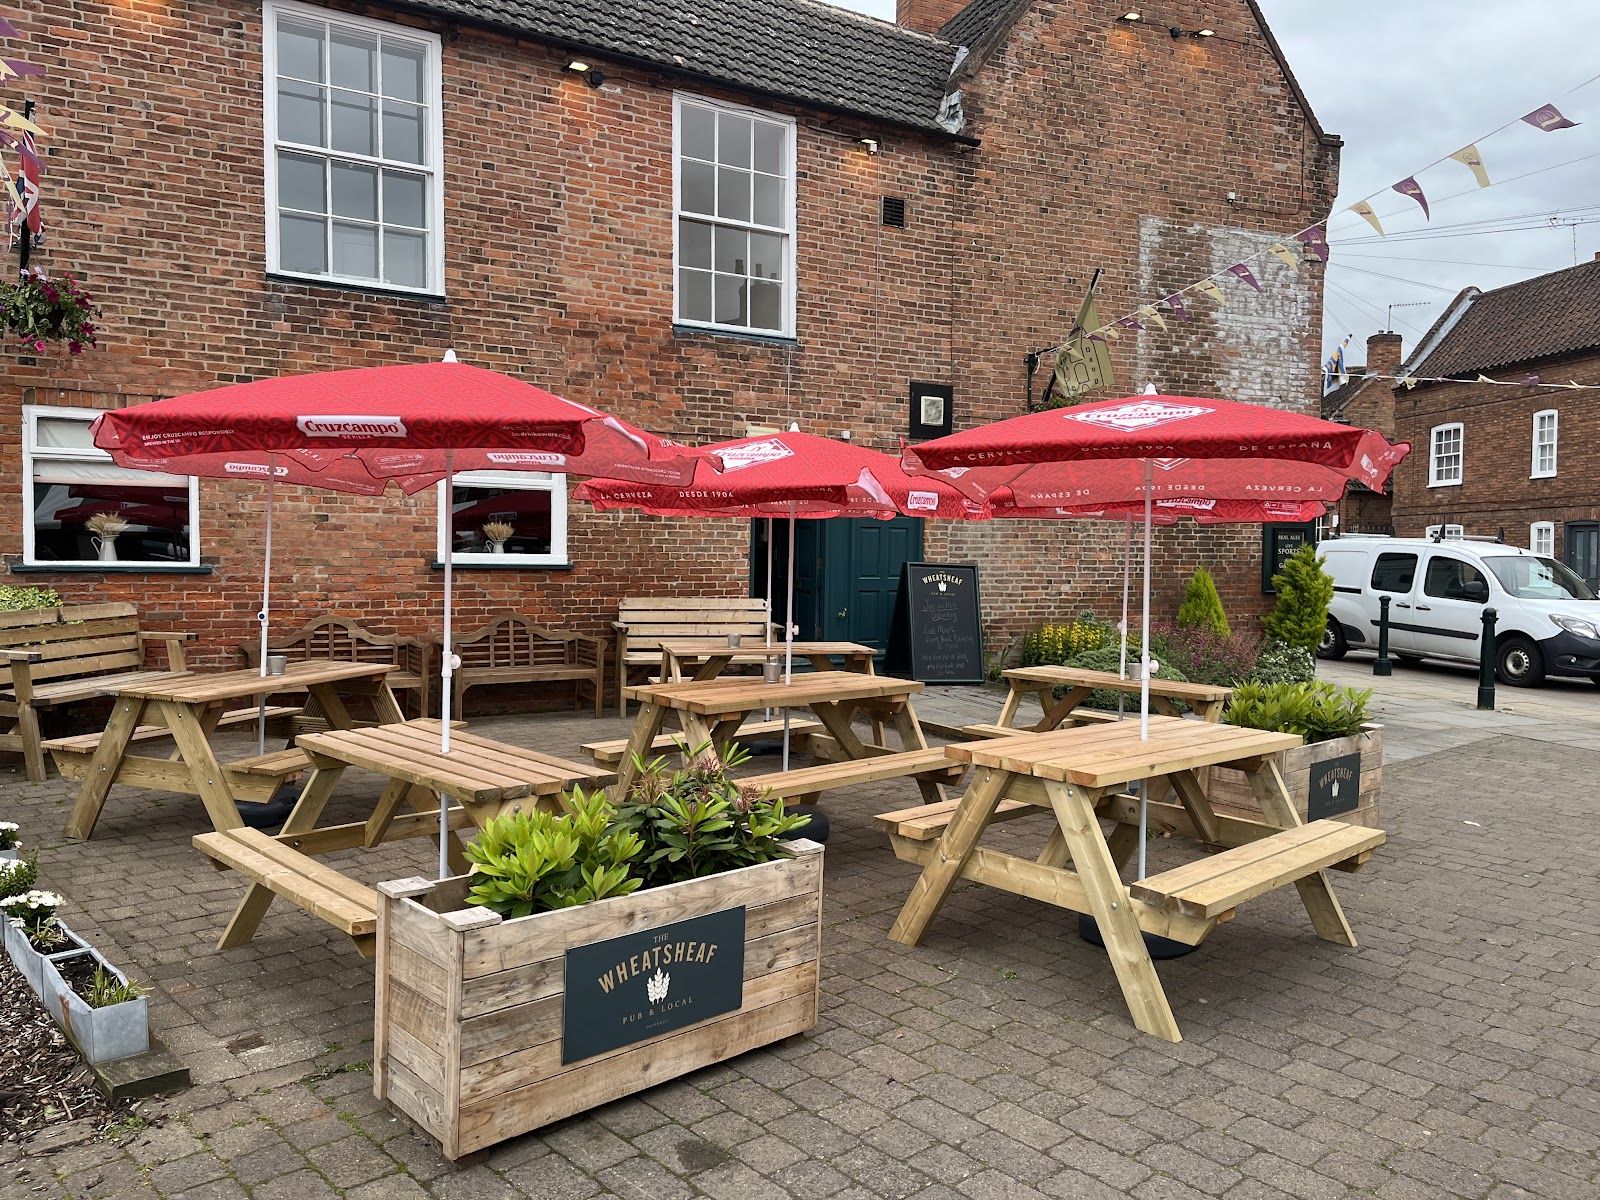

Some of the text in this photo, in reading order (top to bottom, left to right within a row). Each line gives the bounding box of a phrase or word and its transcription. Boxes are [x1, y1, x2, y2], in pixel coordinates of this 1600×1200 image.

[304, 419, 399, 435] Cruzcampo
[679, 490, 708, 498] DESDE
[921, 573, 963, 586] WHEATSHEAF
[1319, 767, 1353, 790] WHEATSHEAF
[653, 933, 669, 943] THE
[597, 941, 719, 994] WHEATSHEAF
[622, 996, 693, 1025] PUB & LOCAL
